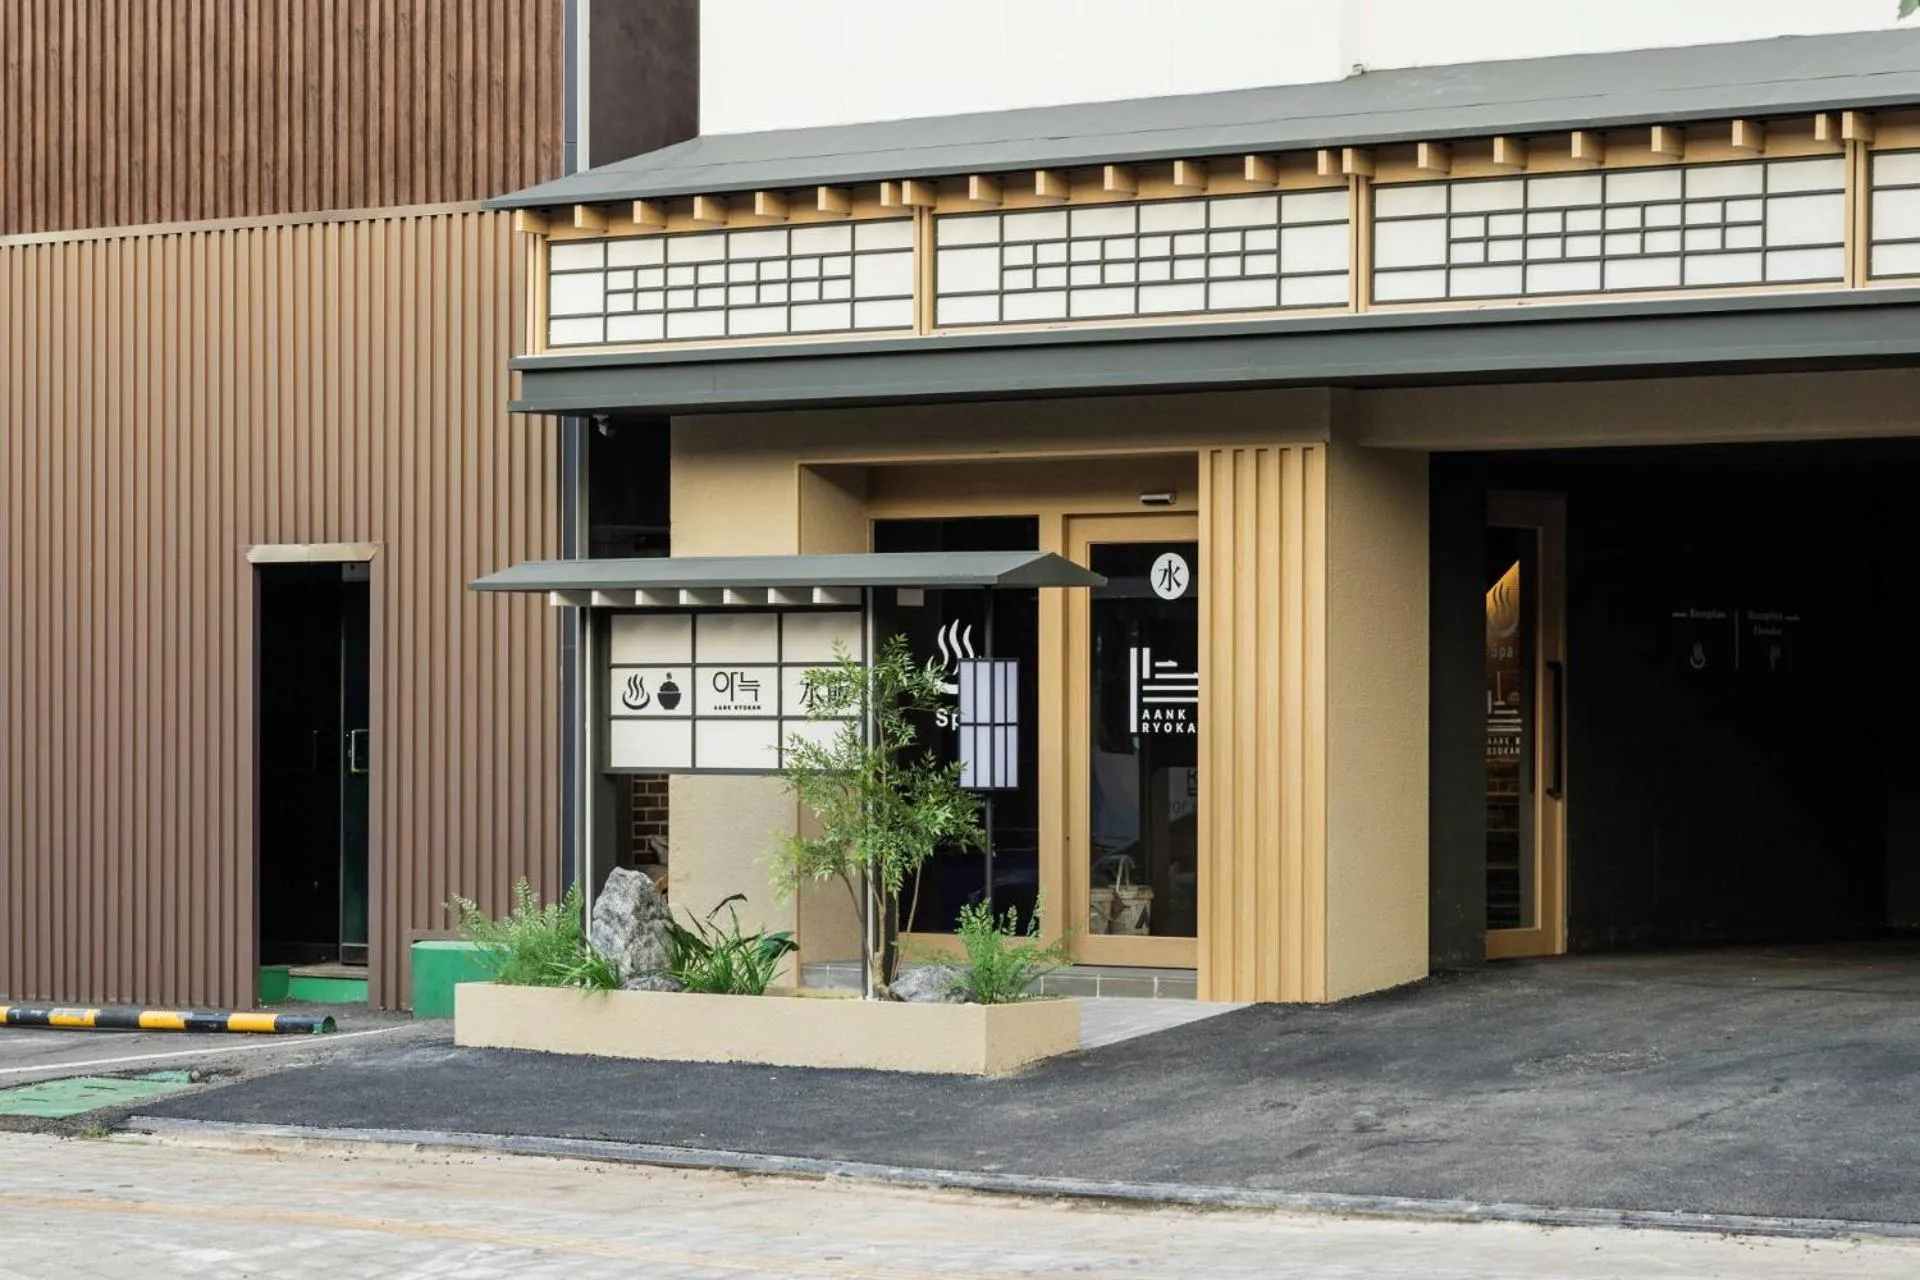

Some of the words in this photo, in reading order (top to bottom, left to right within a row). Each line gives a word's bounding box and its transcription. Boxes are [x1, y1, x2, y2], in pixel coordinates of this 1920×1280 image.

[1158, 560, 1182, 592] 水
[712, 671, 761, 702] 아늑
[935, 708, 959, 731] Sp
[1142, 708, 1186, 720] AANK
[1142, 722, 1197, 733] RYOKA
